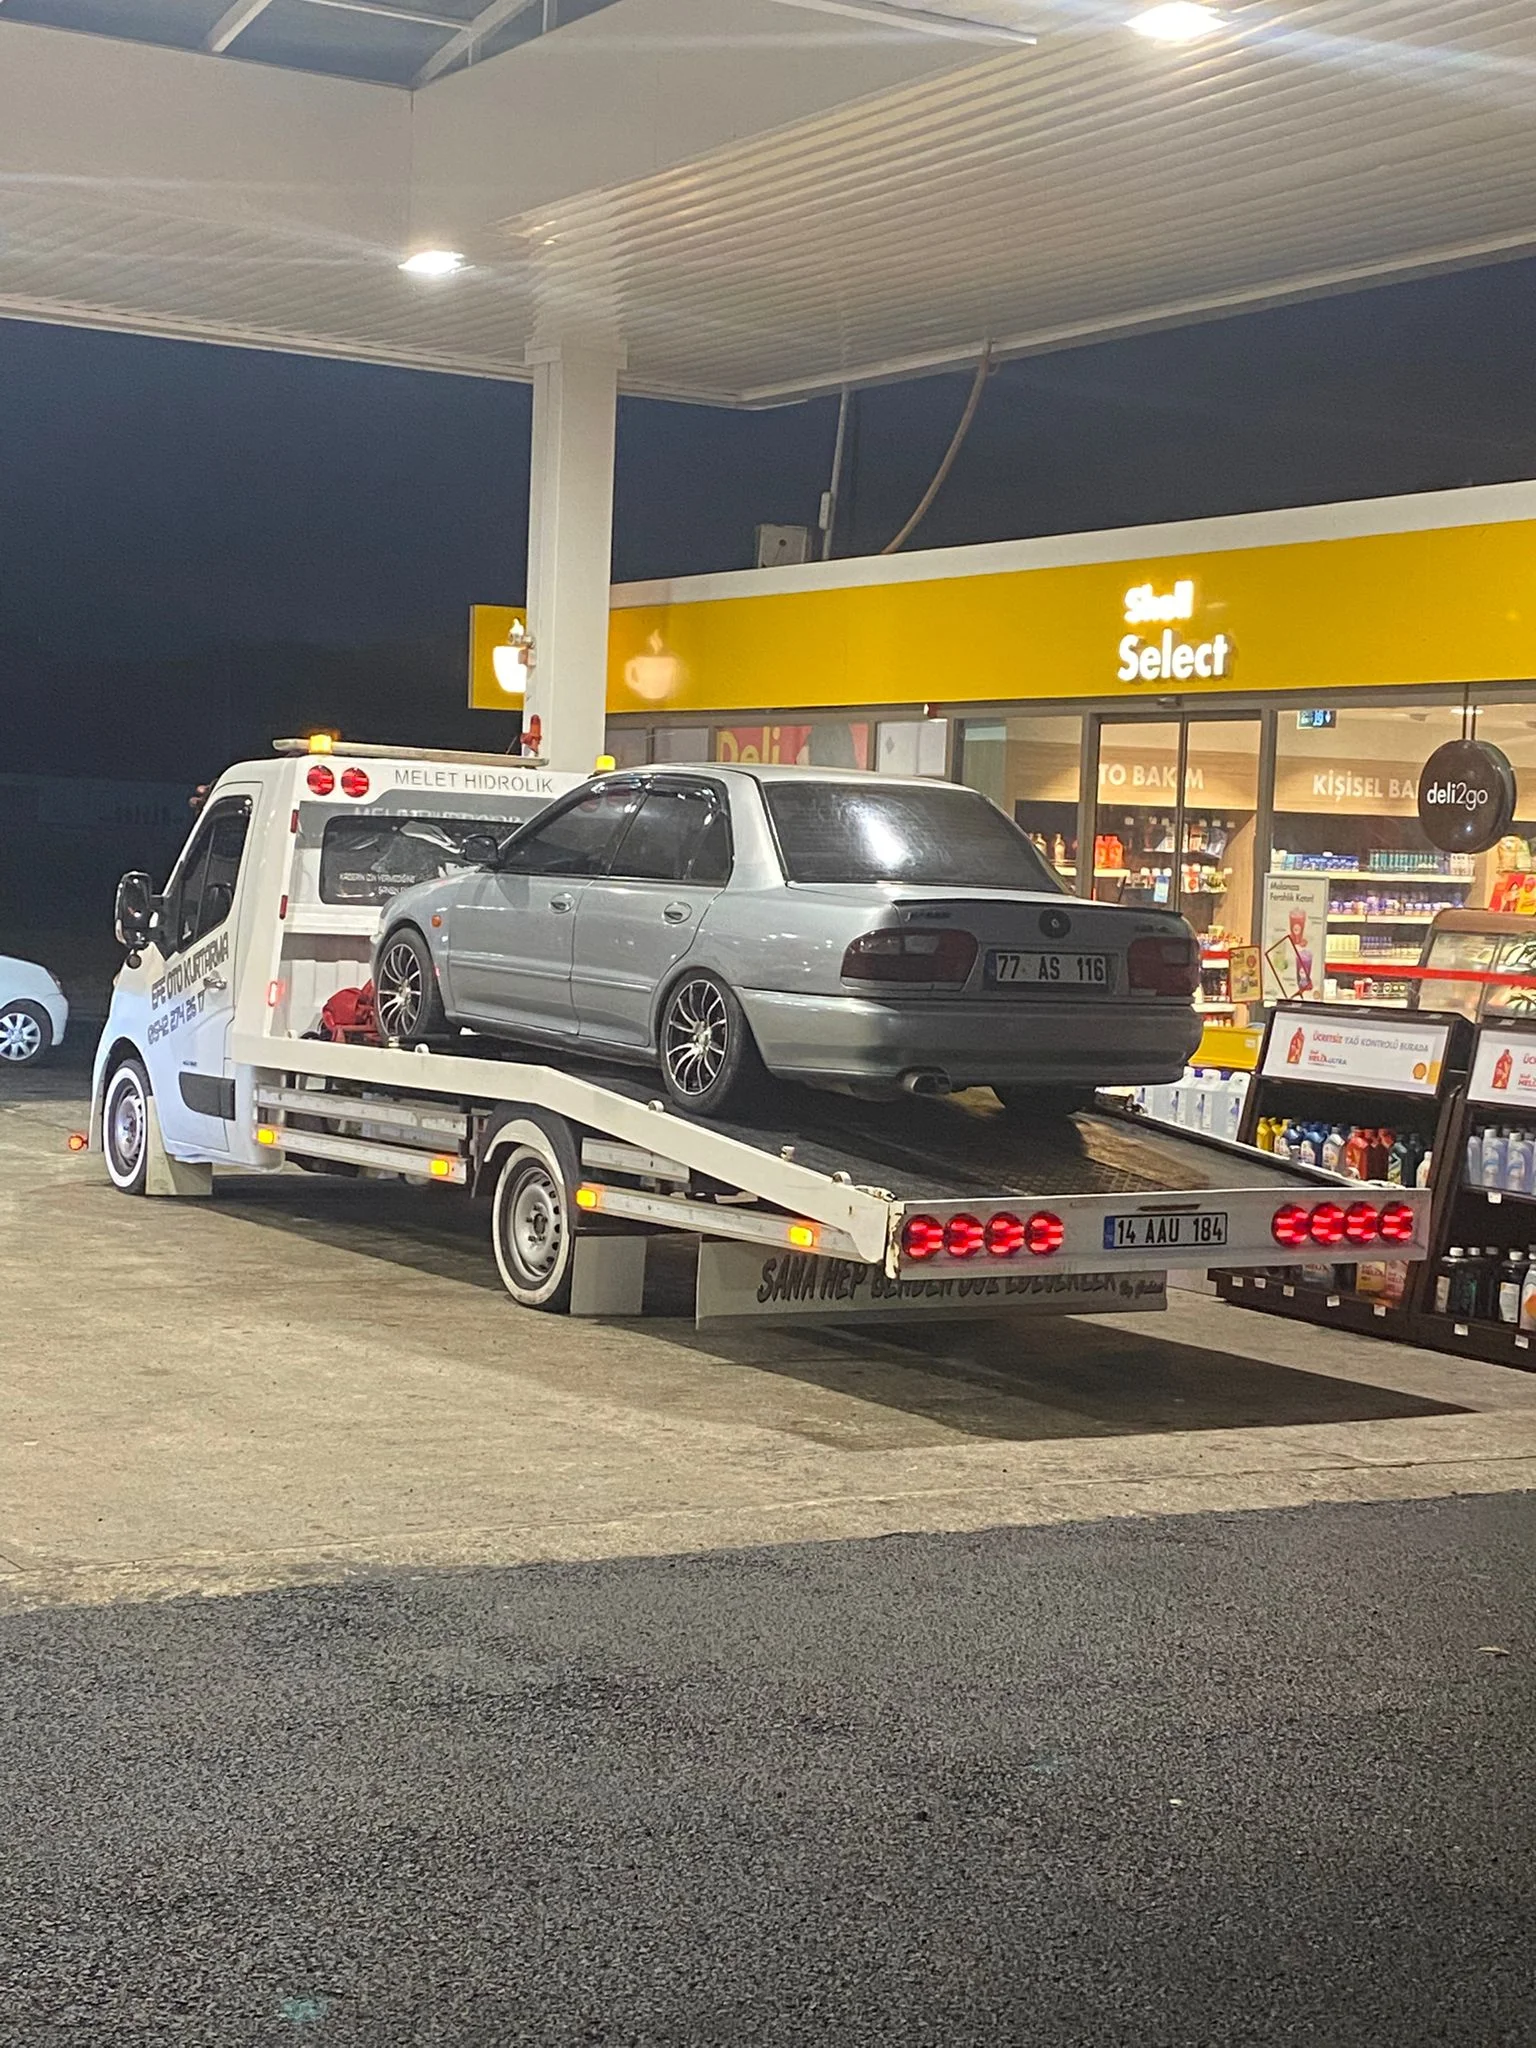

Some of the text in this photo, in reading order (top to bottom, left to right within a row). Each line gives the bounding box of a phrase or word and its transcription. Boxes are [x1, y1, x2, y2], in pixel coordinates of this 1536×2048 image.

[1117, 628, 1229, 681] Select
[395, 769, 458, 788] MELET
[1132, 765, 1204, 790] BAKM
[1312, 769, 1419, 802] KİŞİSEL BA
[1426, 781, 1488, 811] deli2go
[151, 931, 229, 1011] EFE OTO KURTARMA
[998, 955, 1105, 982] 77 AS 116
[1118, 1216, 1224, 1245] 14 AAU 184
[756, 1253, 820, 1304] SANA
